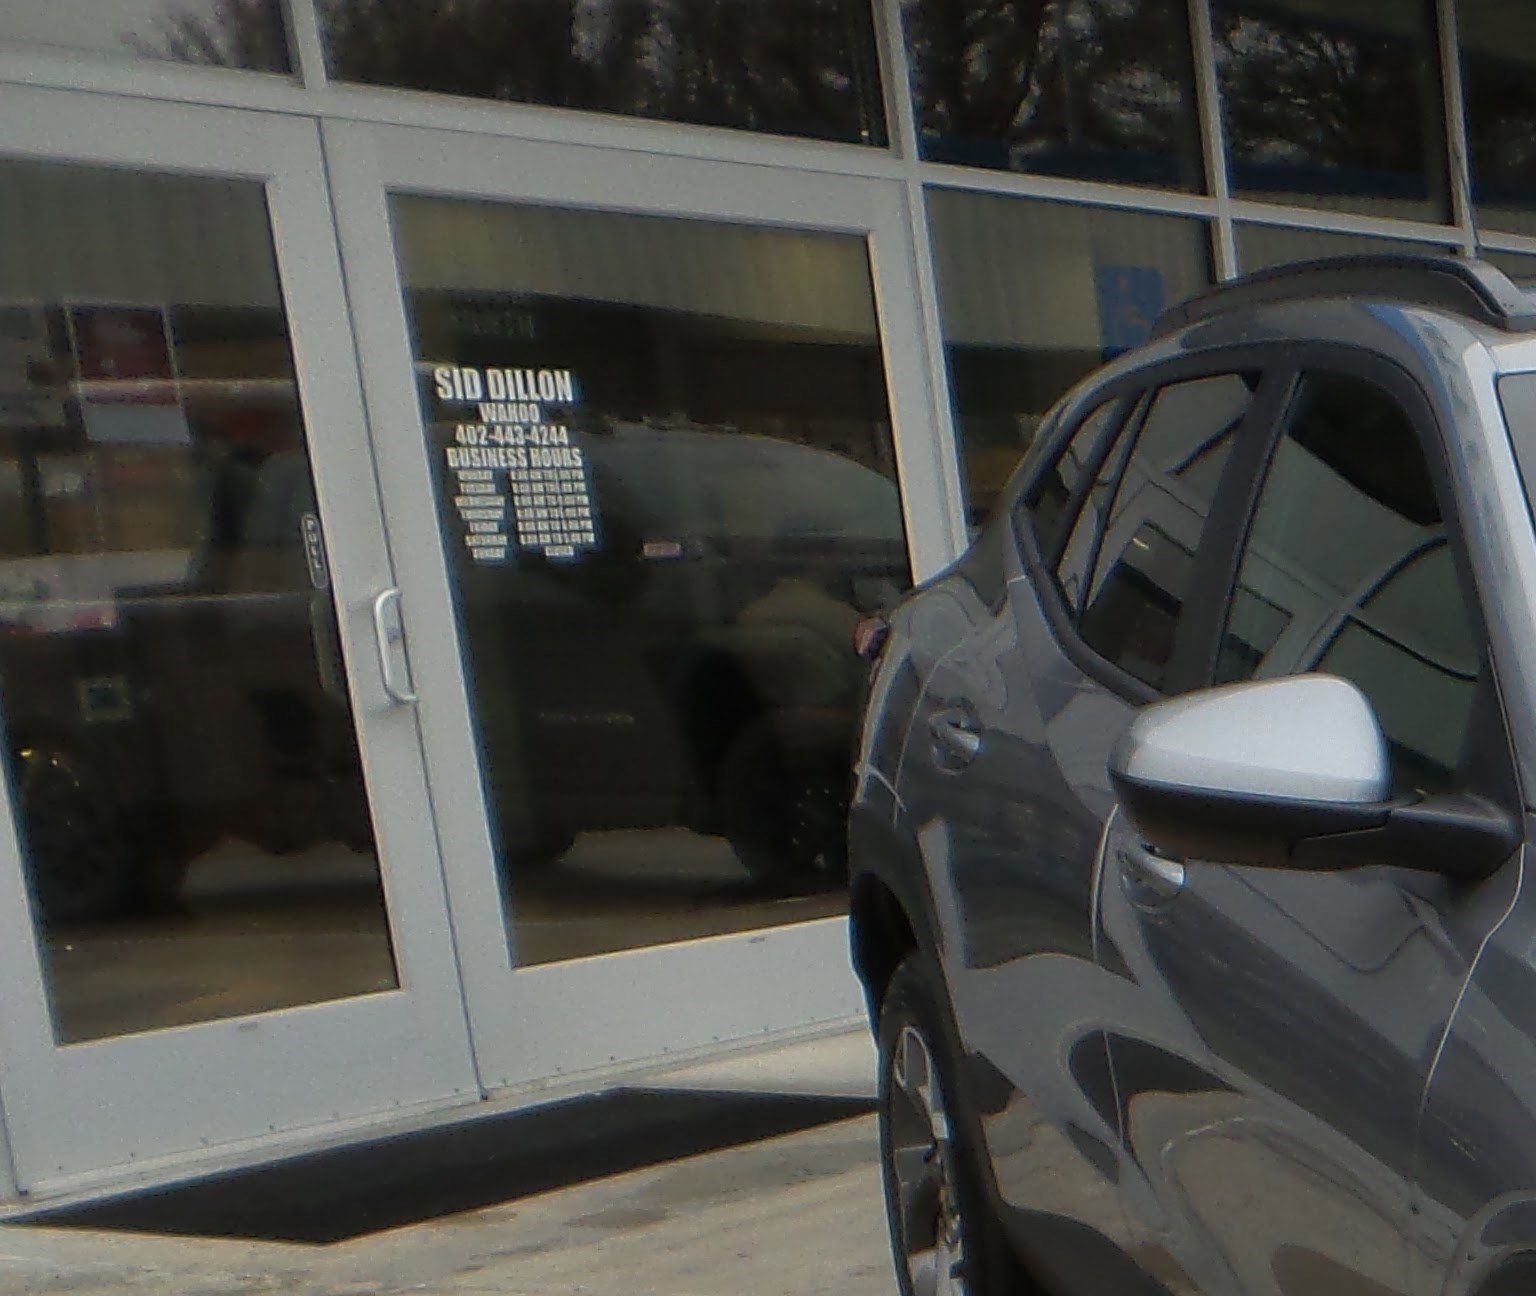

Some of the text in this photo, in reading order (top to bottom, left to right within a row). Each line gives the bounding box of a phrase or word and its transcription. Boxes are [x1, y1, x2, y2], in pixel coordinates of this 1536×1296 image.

[433, 366, 573, 402] SID DILLON
[478, 402, 541, 423] WAHOO
[455, 424, 569, 446] 402-443-4244
[446, 447, 583, 468] BUSINESS HOURS
